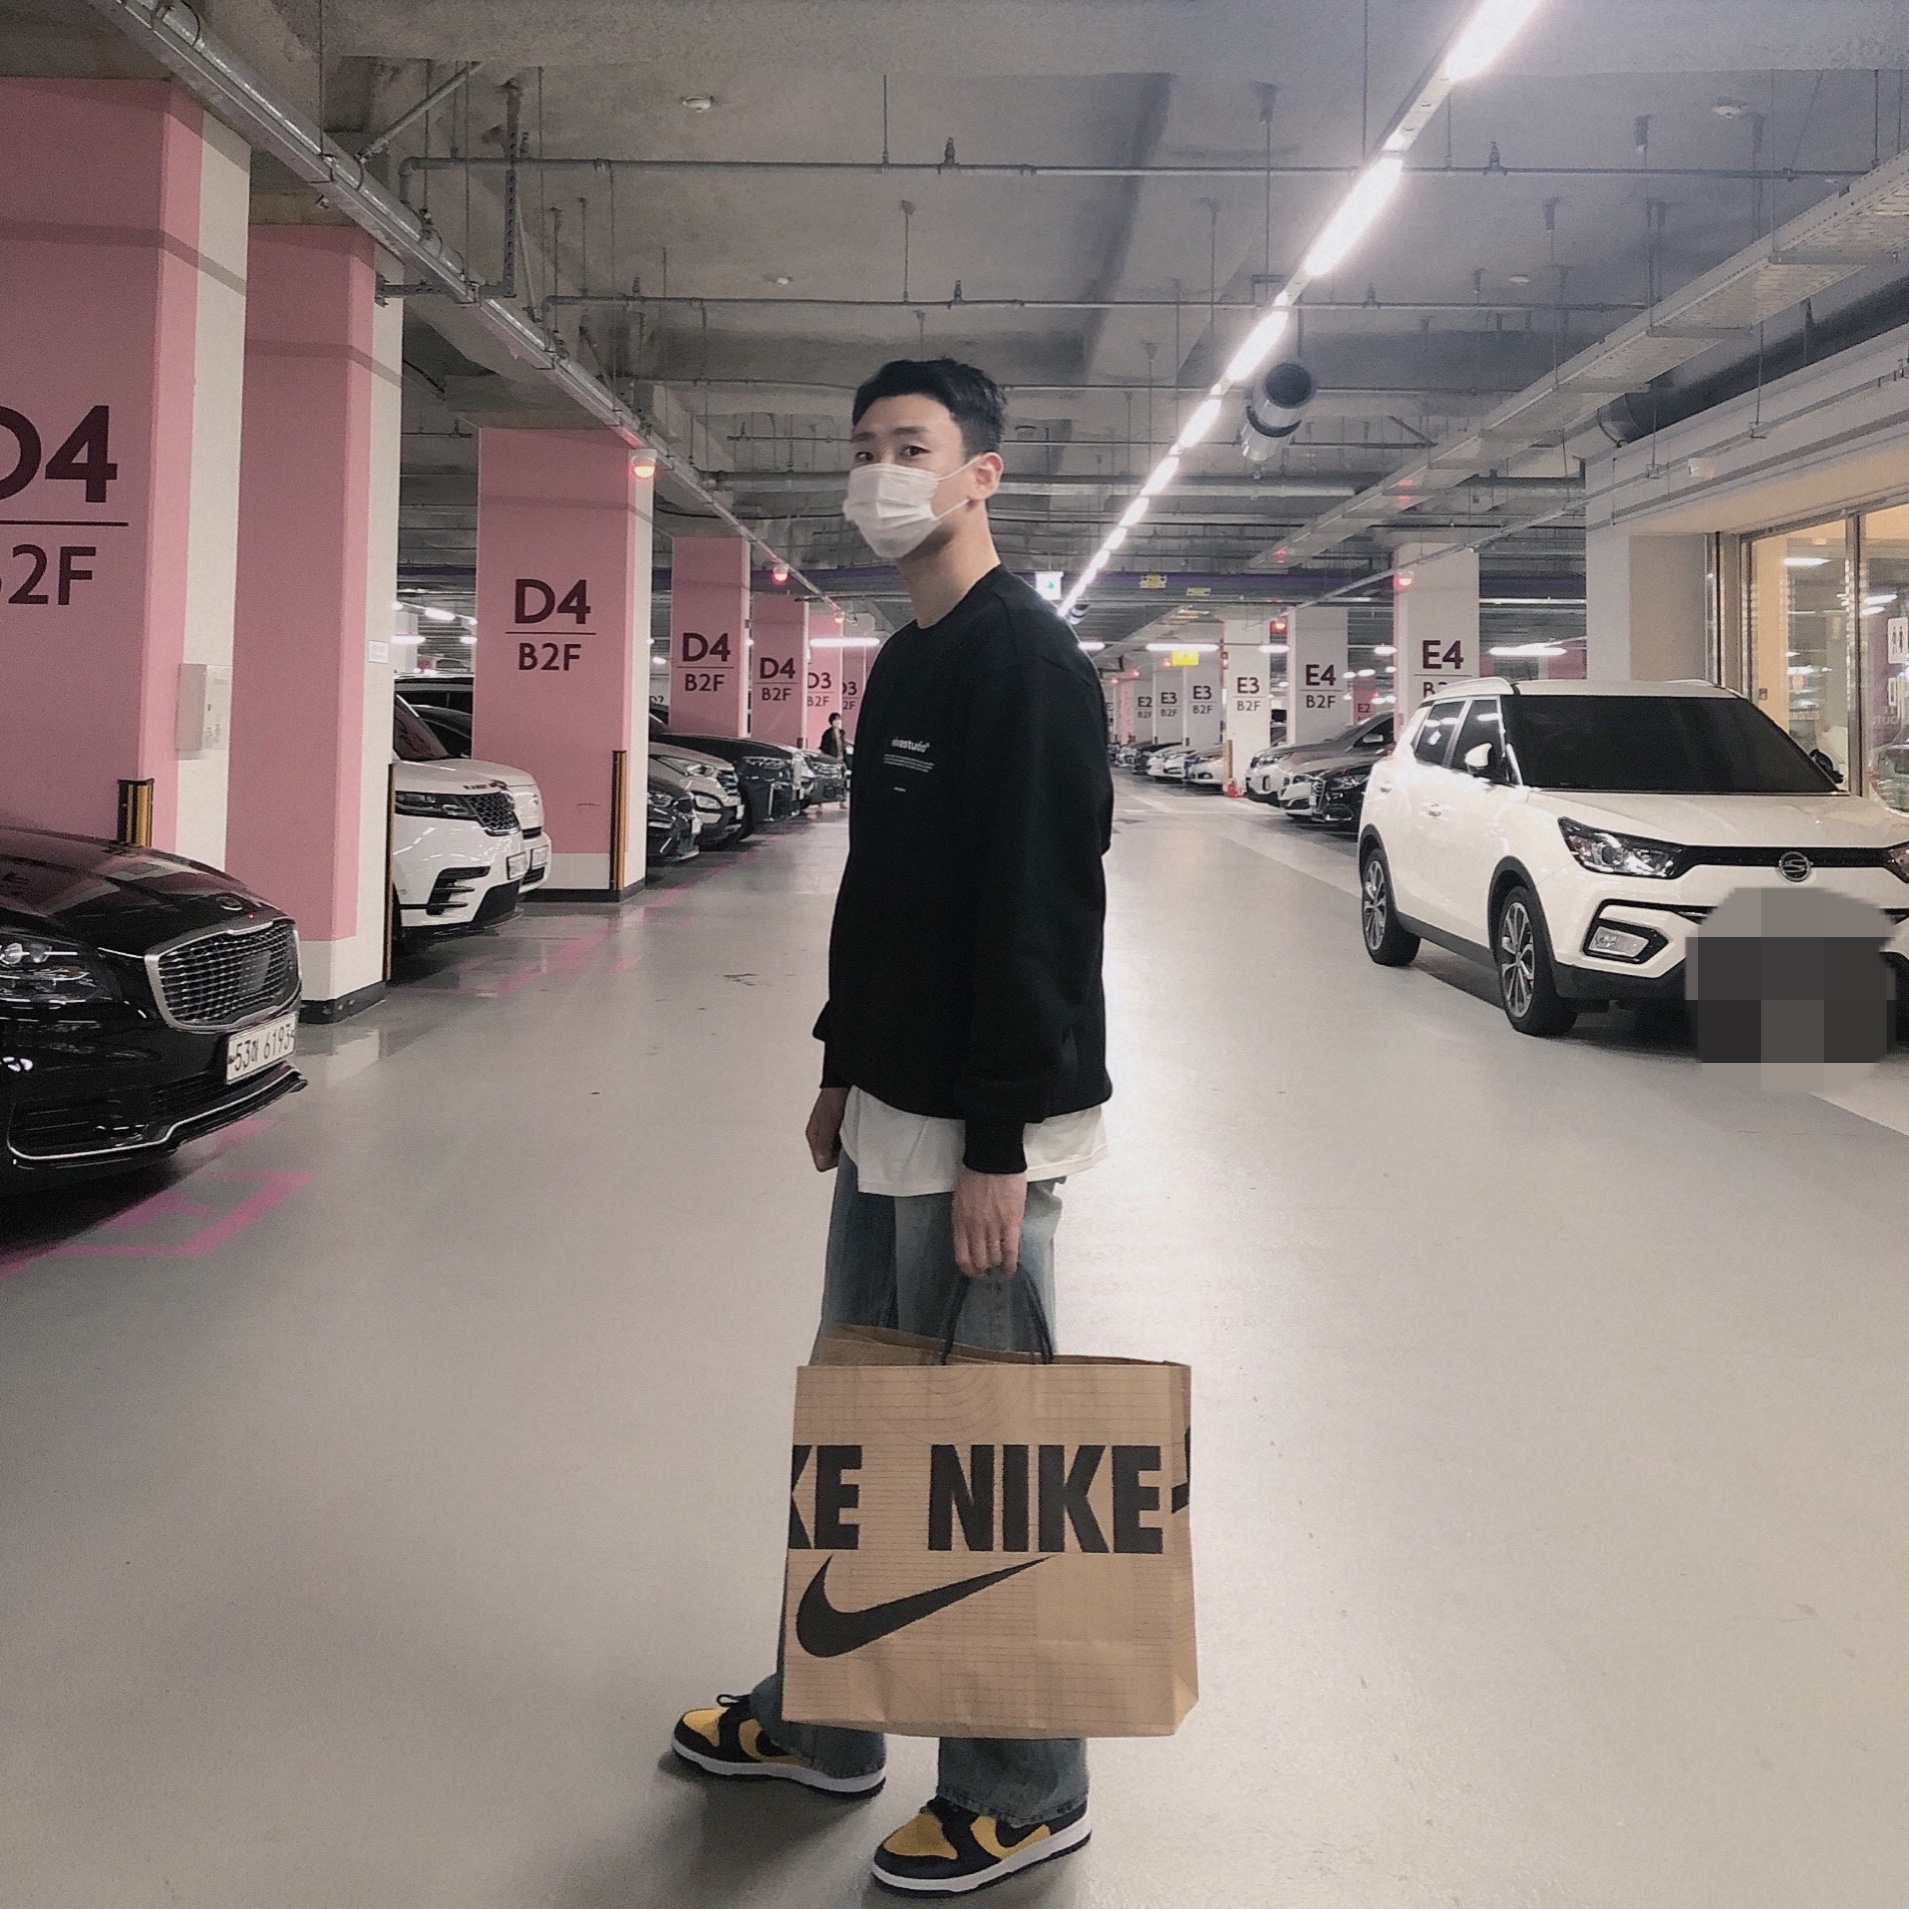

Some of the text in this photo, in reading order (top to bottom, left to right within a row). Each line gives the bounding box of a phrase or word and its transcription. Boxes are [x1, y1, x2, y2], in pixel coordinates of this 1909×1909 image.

[0, 544, 97, 605] 2F
[515, 578, 591, 624] D4
[682, 632, 731, 662] D4
[1422, 640, 1464, 669] E4
[518, 642, 582, 671] B2F
[760, 657, 796, 679] D4
[1305, 664, 1337, 686] E4
[685, 673, 725, 692] B2F
[1237, 677, 1260, 694] E3
[762, 687, 792, 701] B2F
[1160, 692, 1178, 704] E3
[1193, 685, 1212, 700] E3
[1137, 696, 1153, 707] E2
[1193, 705, 1213, 714] B2F
[1236, 701, 1262, 711] B2F
[1306, 695, 1337, 708] B2F
[1357, 703, 1370, 713] E2
[1161, 709, 1178, 717] B2F
[928, 1444, 1164, 1554] NIKE
